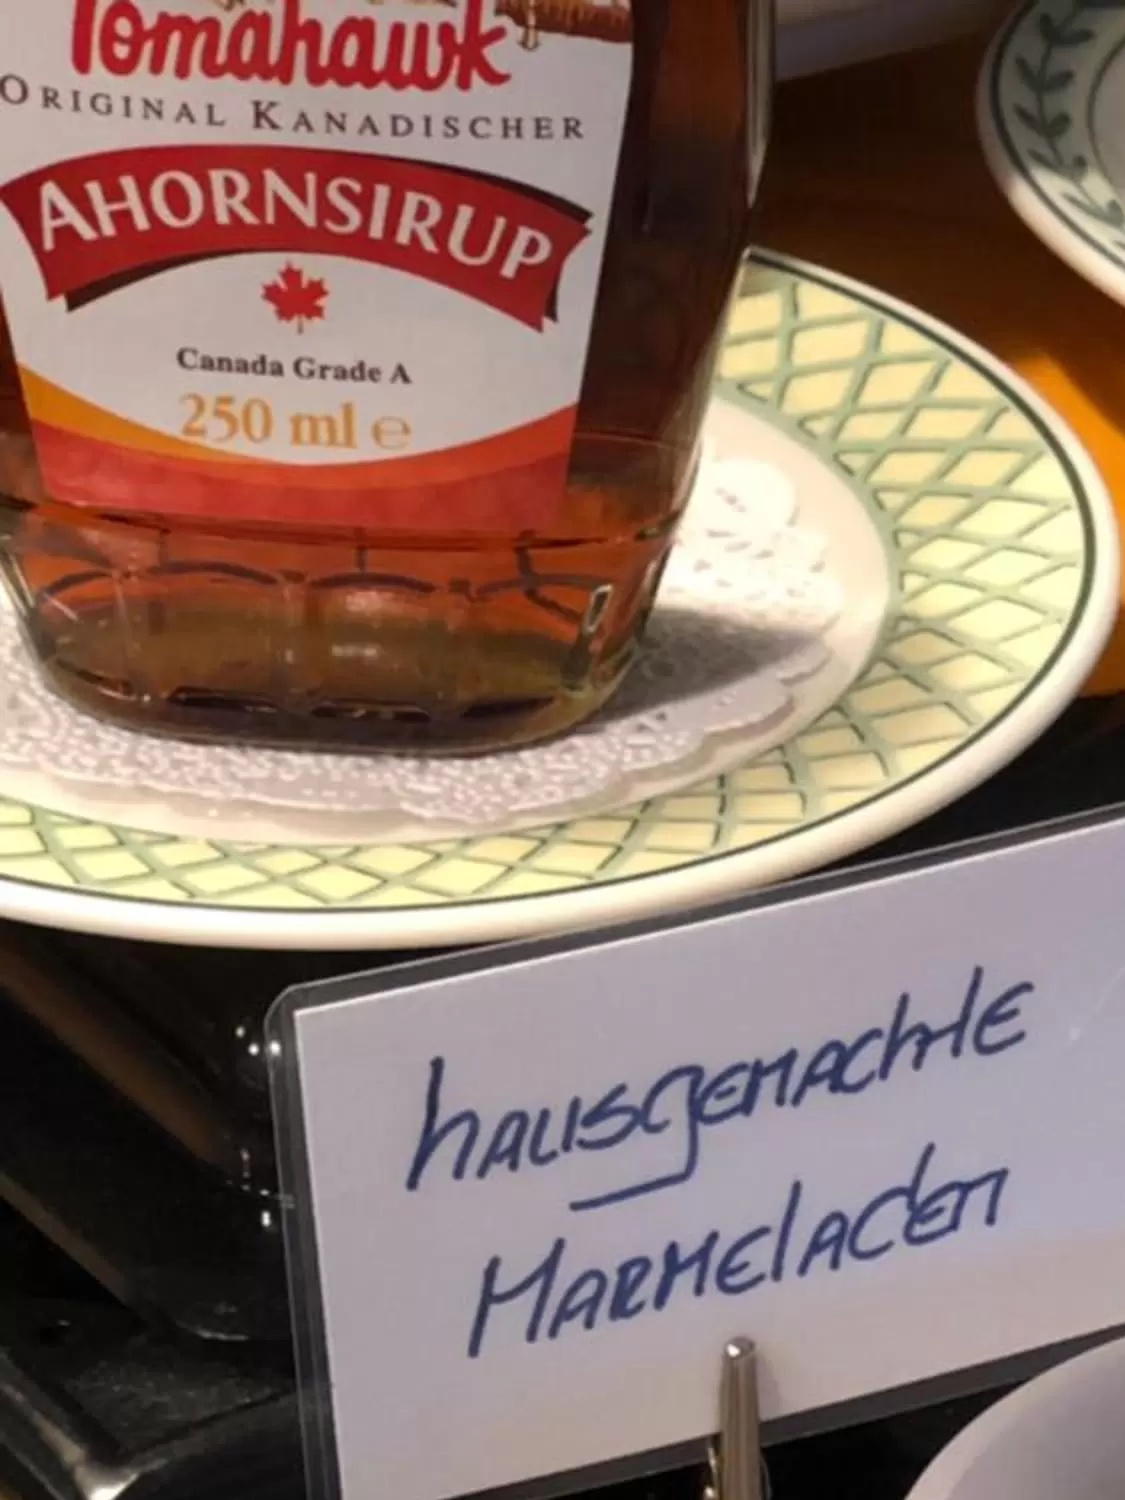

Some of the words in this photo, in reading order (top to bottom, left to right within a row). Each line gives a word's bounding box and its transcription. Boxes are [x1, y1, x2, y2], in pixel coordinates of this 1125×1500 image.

[0, 75, 226, 128] ORIGINAL
[252, 100, 585, 141] KANADISCHER
[40, 168, 553, 280] AHORNSIRUP
[176, 347, 285, 378] Canada
[292, 356, 383, 383] Grade
[389, 361, 413, 385] A
[179, 392, 274, 444] 250
[288, 401, 357, 450] ml
